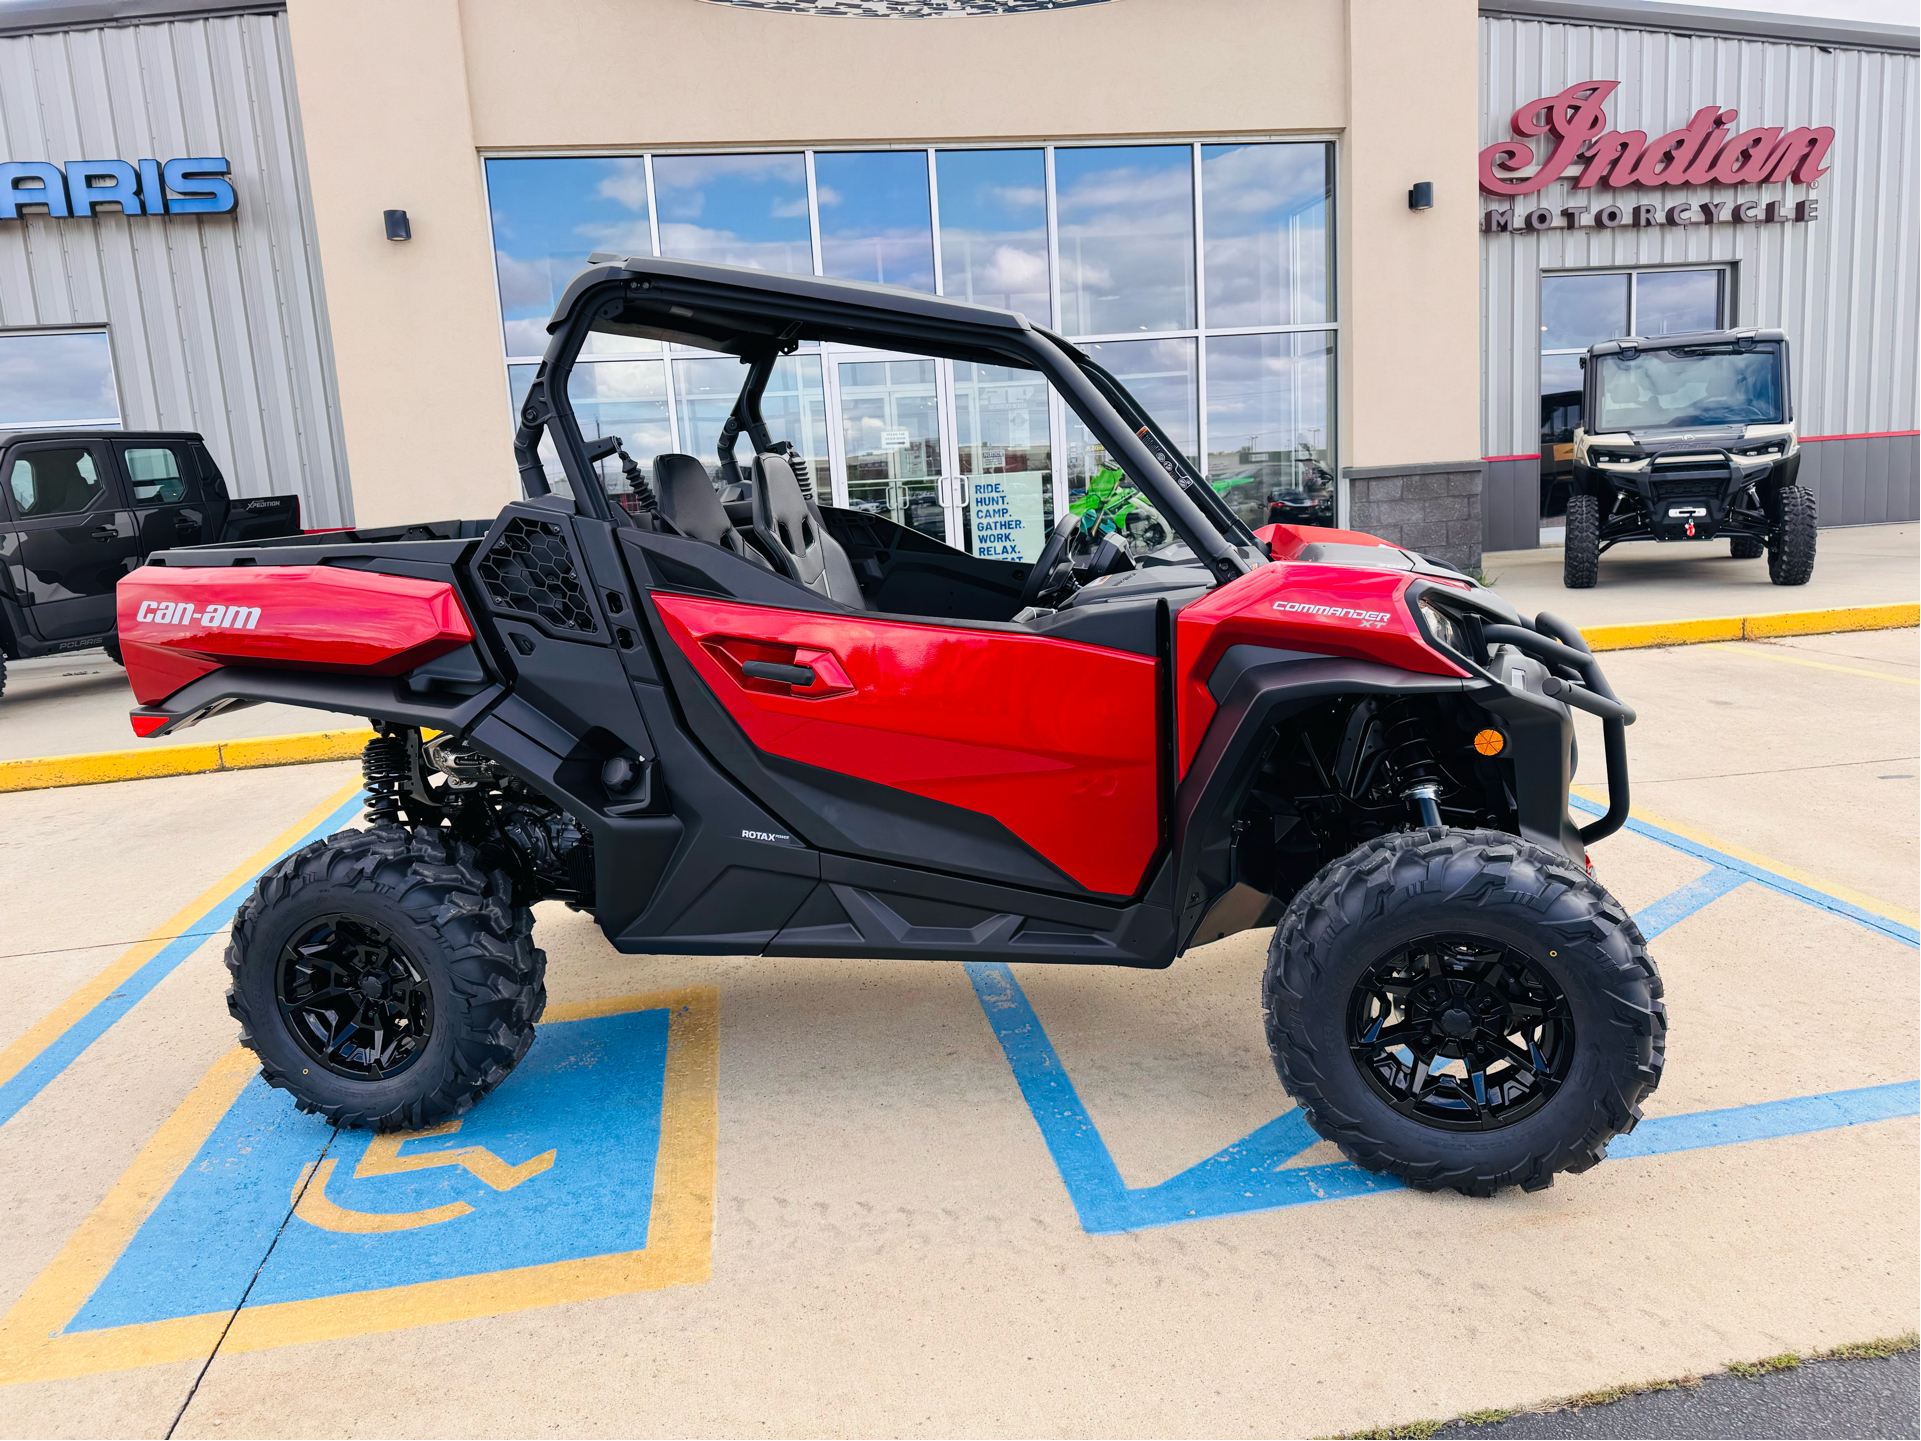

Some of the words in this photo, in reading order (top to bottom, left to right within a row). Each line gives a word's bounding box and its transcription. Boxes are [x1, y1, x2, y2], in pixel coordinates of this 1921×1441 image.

[1479, 80, 1835, 196] Indian
[1484, 198, 1819, 234] MOTORCYCLE
[975, 483, 1004, 494] RIDE.
[246, 500, 281, 511] XPEDITION
[975, 495, 1009, 507] HUNT.
[976, 508, 1012, 519] CAMP.
[977, 519, 1025, 532] GATHER.
[978, 532, 1015, 544] WORK.
[978, 544, 1021, 556] RELAX.
[136, 600, 261, 630] can-am
[1272, 601, 1391, 622] COMMANDER
[1358, 620, 1386, 629] XT
[60, 637, 103, 650] POLARIS
[741, 829, 776, 841] ROTAX
